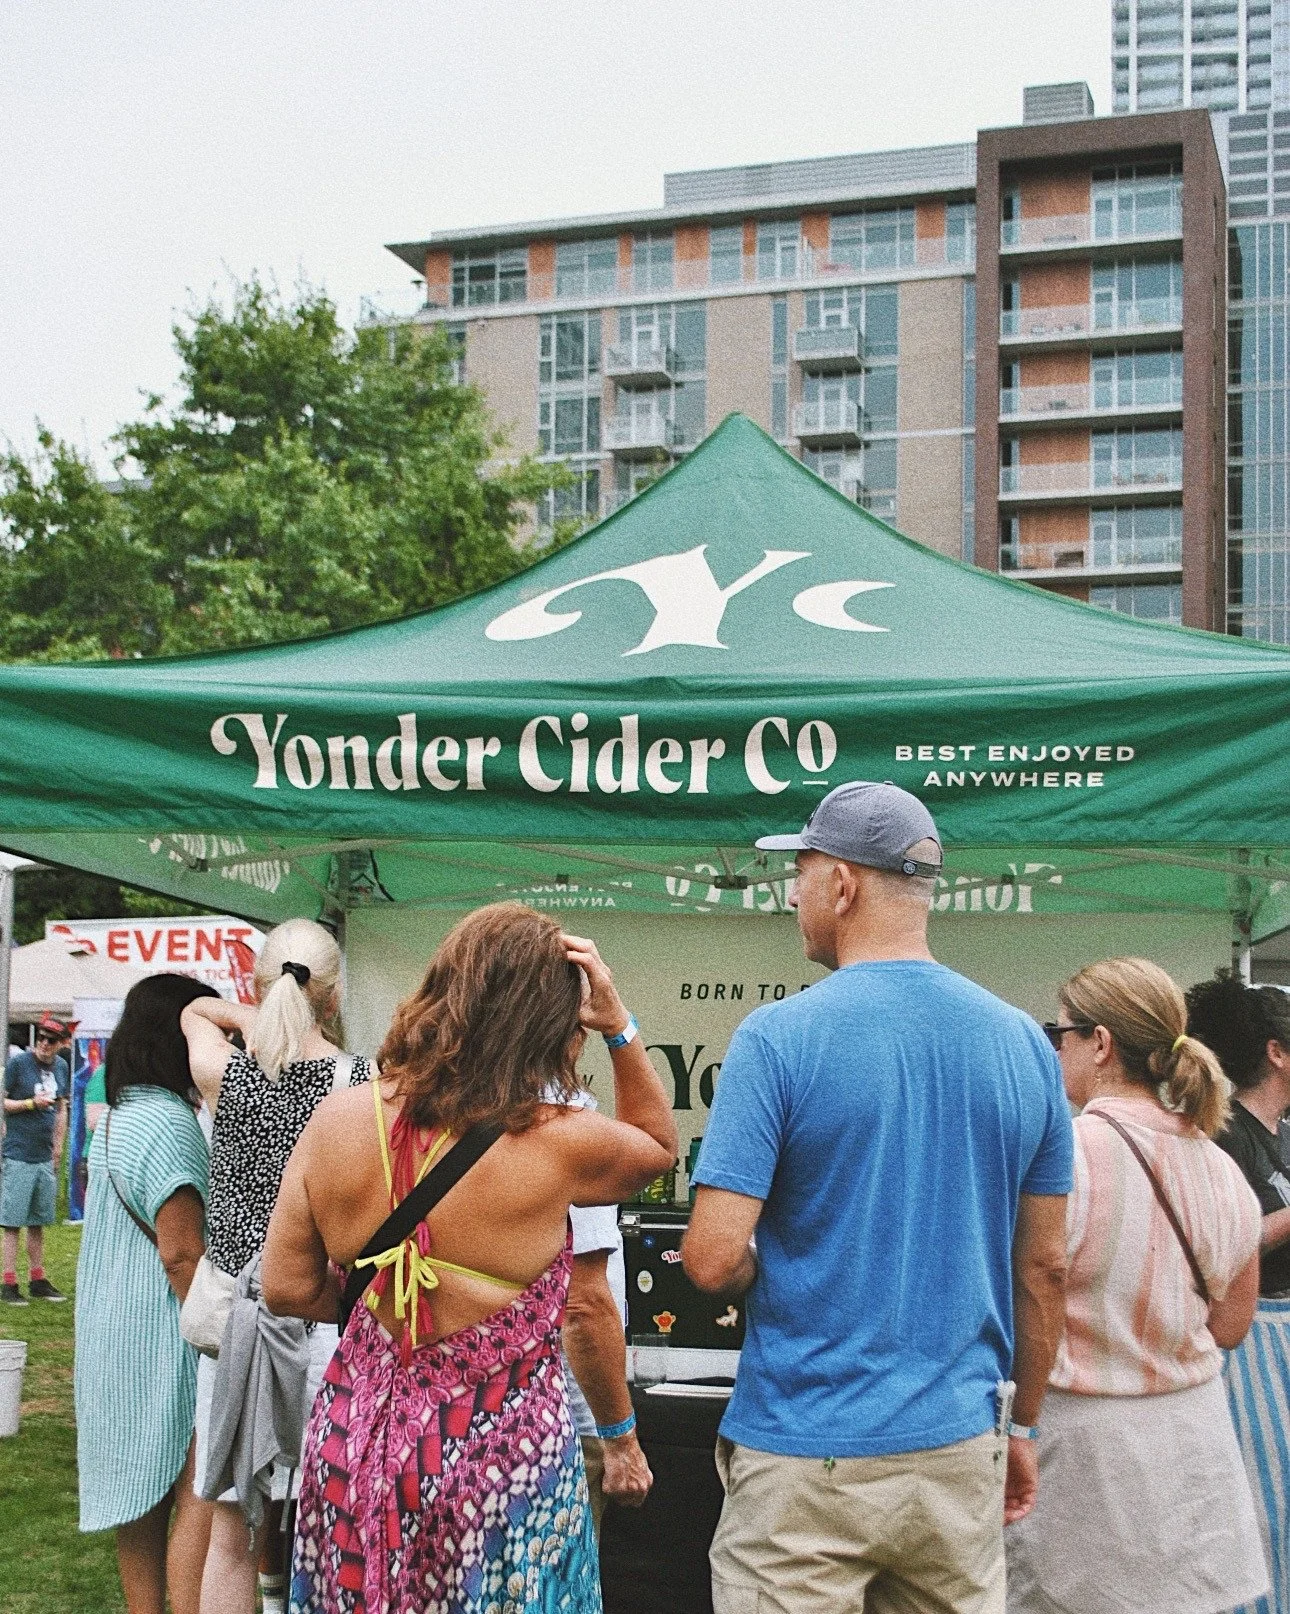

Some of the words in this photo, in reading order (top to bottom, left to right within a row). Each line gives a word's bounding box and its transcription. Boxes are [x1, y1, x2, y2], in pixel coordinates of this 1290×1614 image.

[210, 712, 501, 791] Yonder
[518, 712, 726, 794] Cider
[744, 716, 838, 795] Co
[895, 745, 976, 762] BEST
[988, 745, 1136, 762] ENJOYED
[923, 771, 1105, 788] ANYWHERE
[107, 928, 253, 963] EVENT
[680, 983, 744, 1000] BORN
[757, 984, 786, 1001] TO
